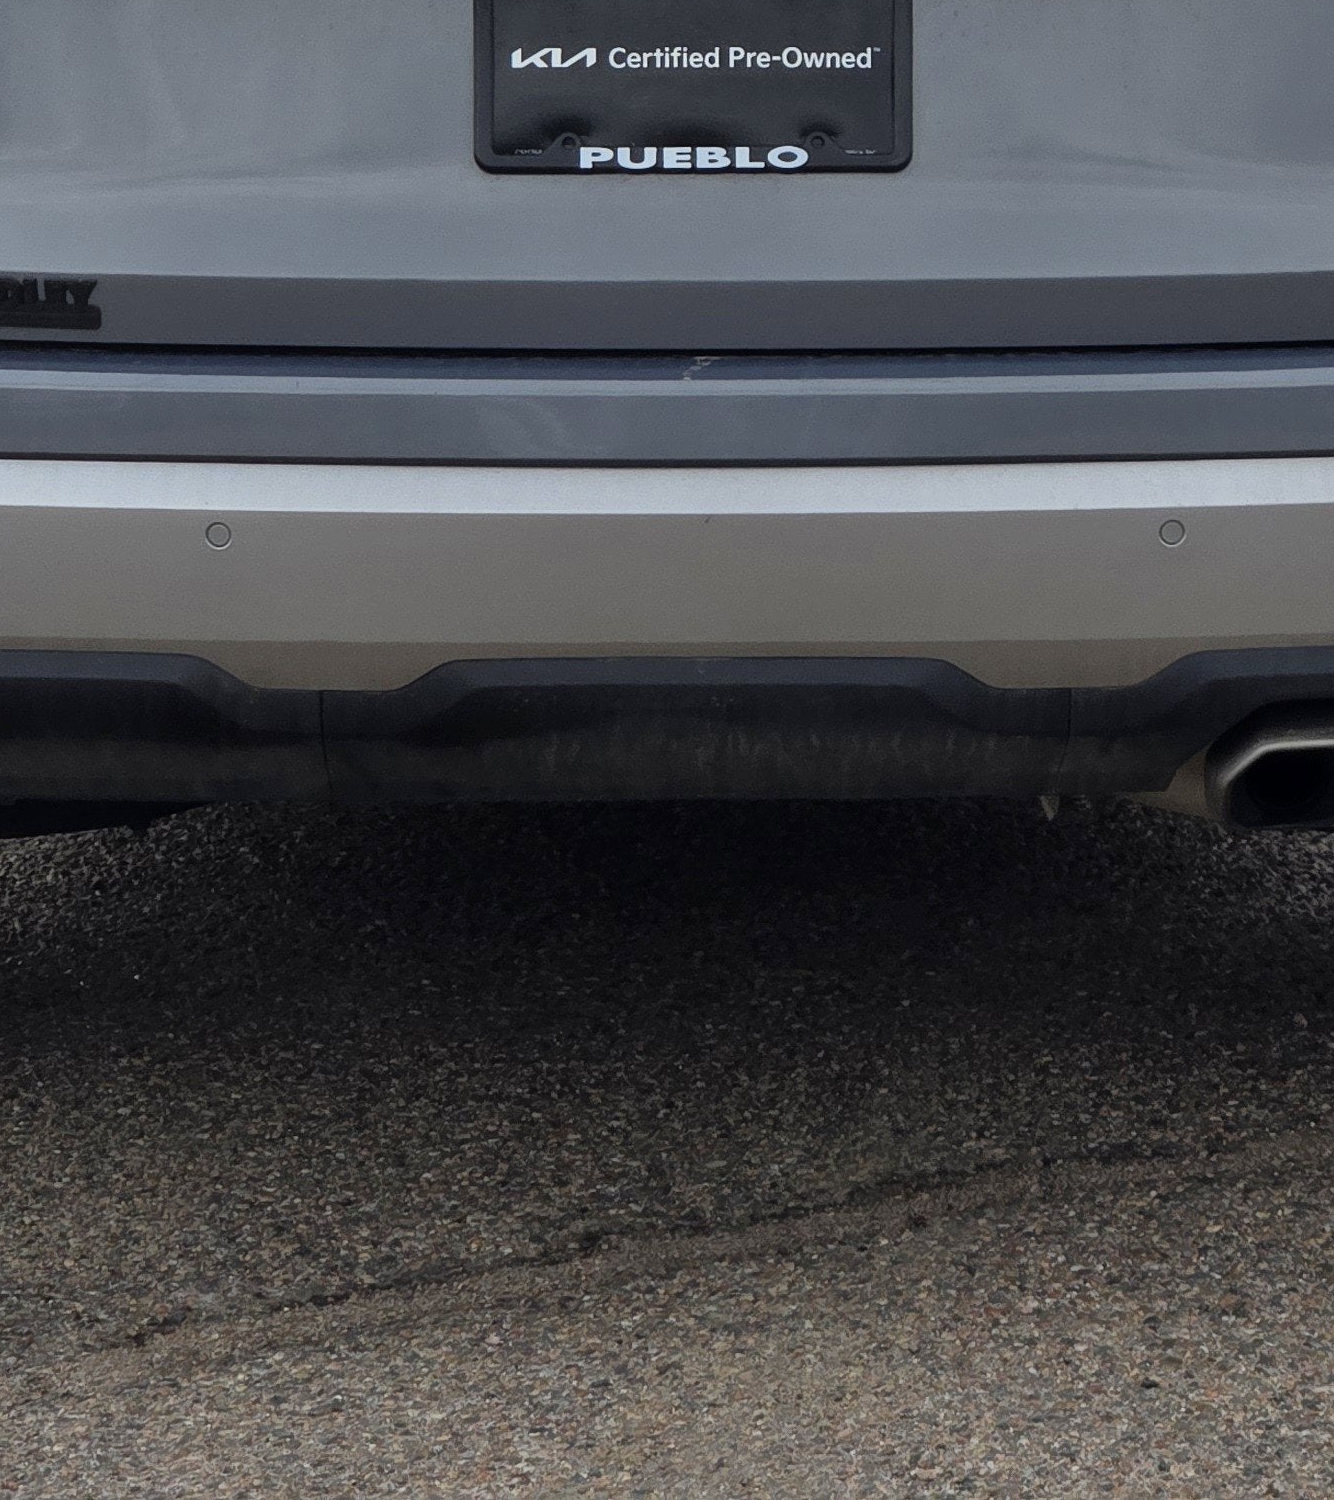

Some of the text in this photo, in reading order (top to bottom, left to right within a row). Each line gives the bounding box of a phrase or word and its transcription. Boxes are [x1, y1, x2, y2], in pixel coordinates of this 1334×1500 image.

[510, 47, 597, 69] KIA
[608, 46, 720, 69] Certified
[579, 145, 809, 170] PUEBLO
